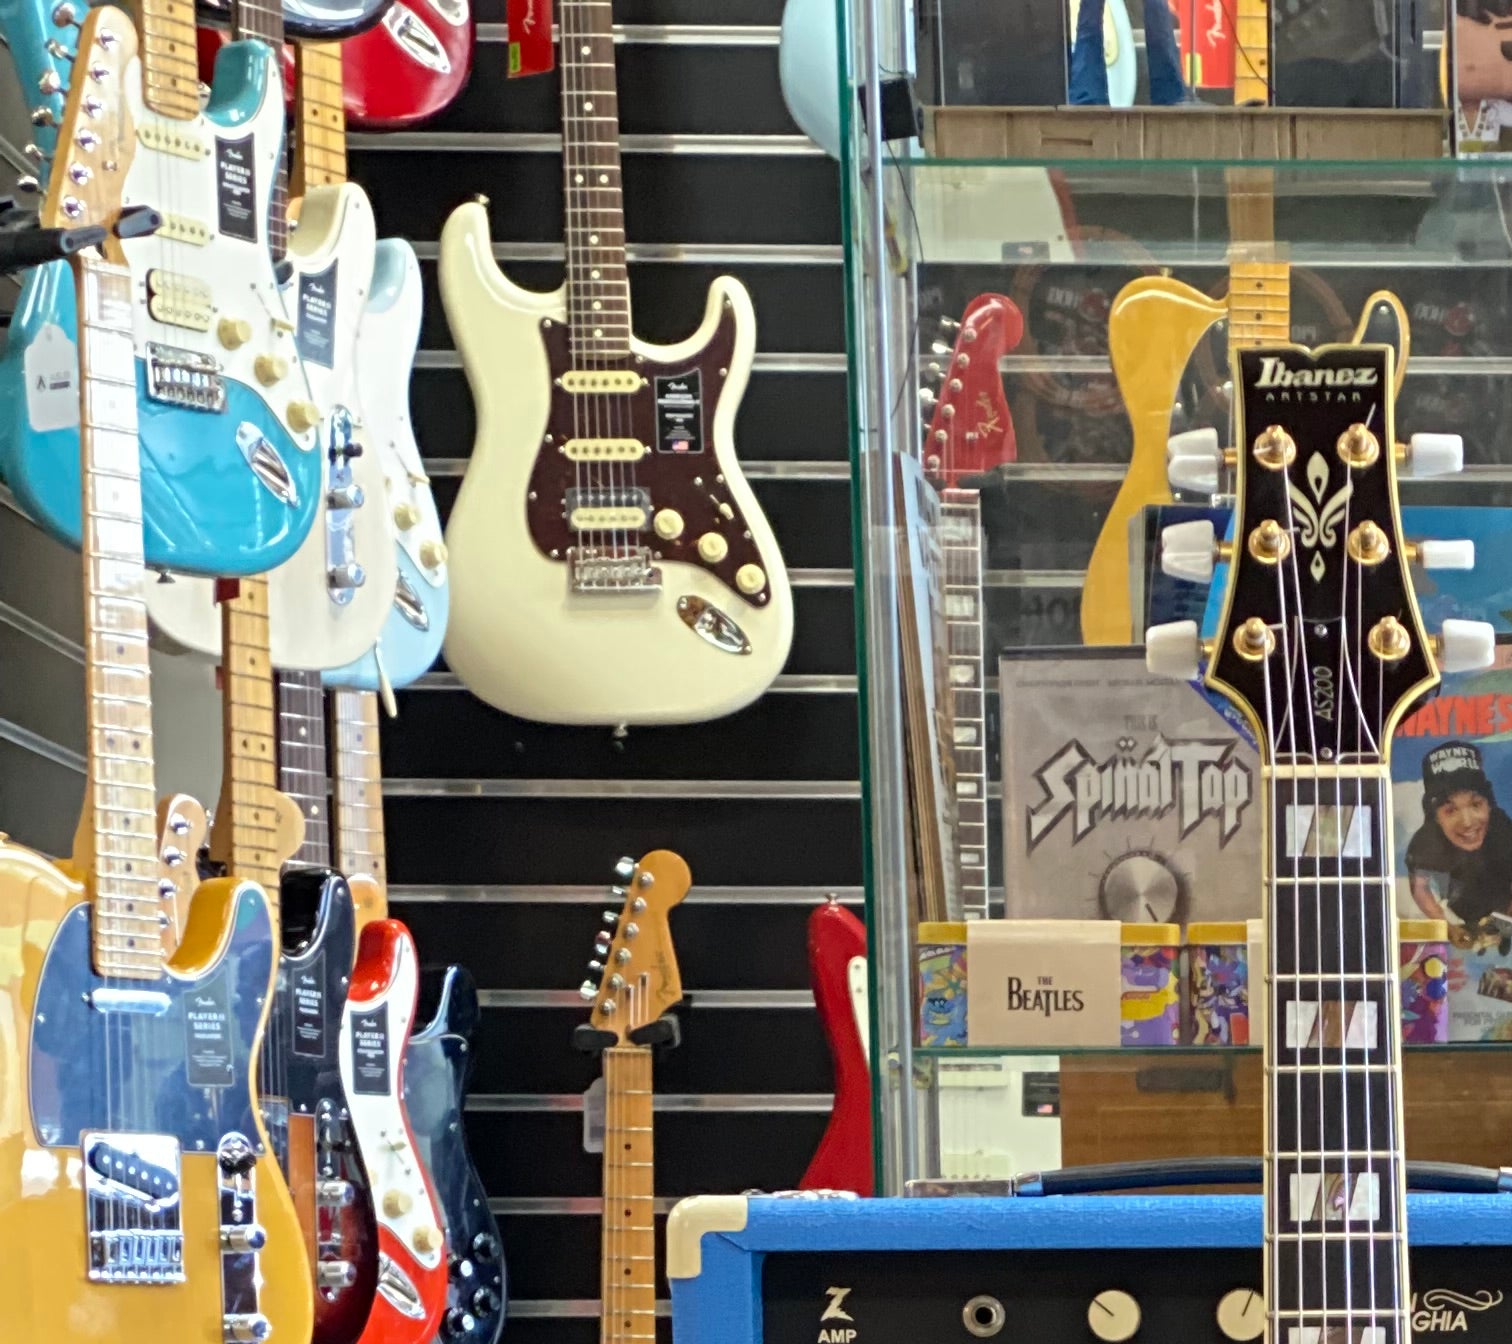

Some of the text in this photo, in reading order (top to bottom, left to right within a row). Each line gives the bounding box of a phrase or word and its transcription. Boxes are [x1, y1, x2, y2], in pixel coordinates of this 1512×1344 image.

[1254, 356, 1379, 388] Ibanez
[1265, 391, 1362, 402] ARTSTAR
[1312, 665, 1335, 721] AS200
[1038, 976, 1053, 985] THE
[1008, 976, 1085, 1017] BEATLES
[1412, 1310, 1468, 1332] GHIA
[817, 1328, 857, 1344] AMP
